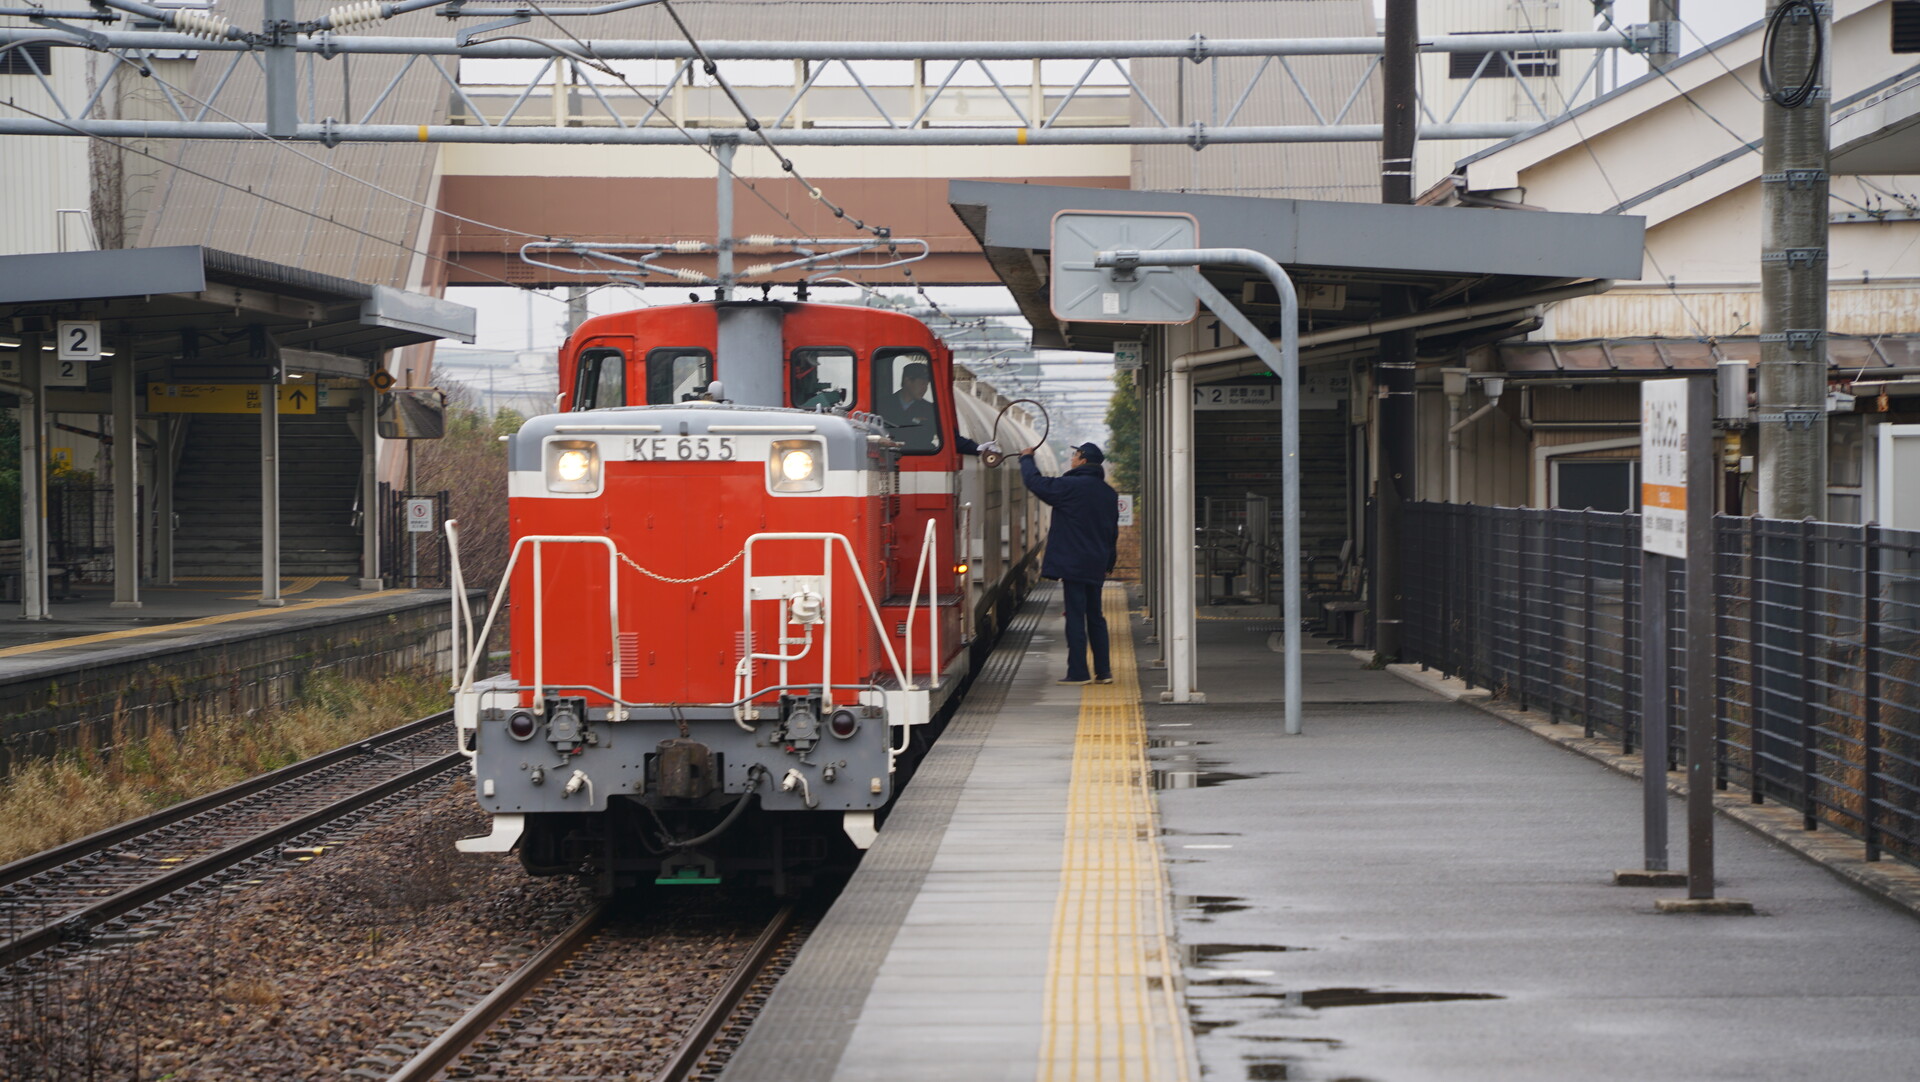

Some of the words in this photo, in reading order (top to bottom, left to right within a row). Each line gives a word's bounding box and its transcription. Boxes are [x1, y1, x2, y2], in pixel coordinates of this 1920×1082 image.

[70, 328, 88, 351] 2
[1207, 320, 1221, 348] 1
[61, 361, 74, 377] 2
[1212, 390, 1222, 403] 2
